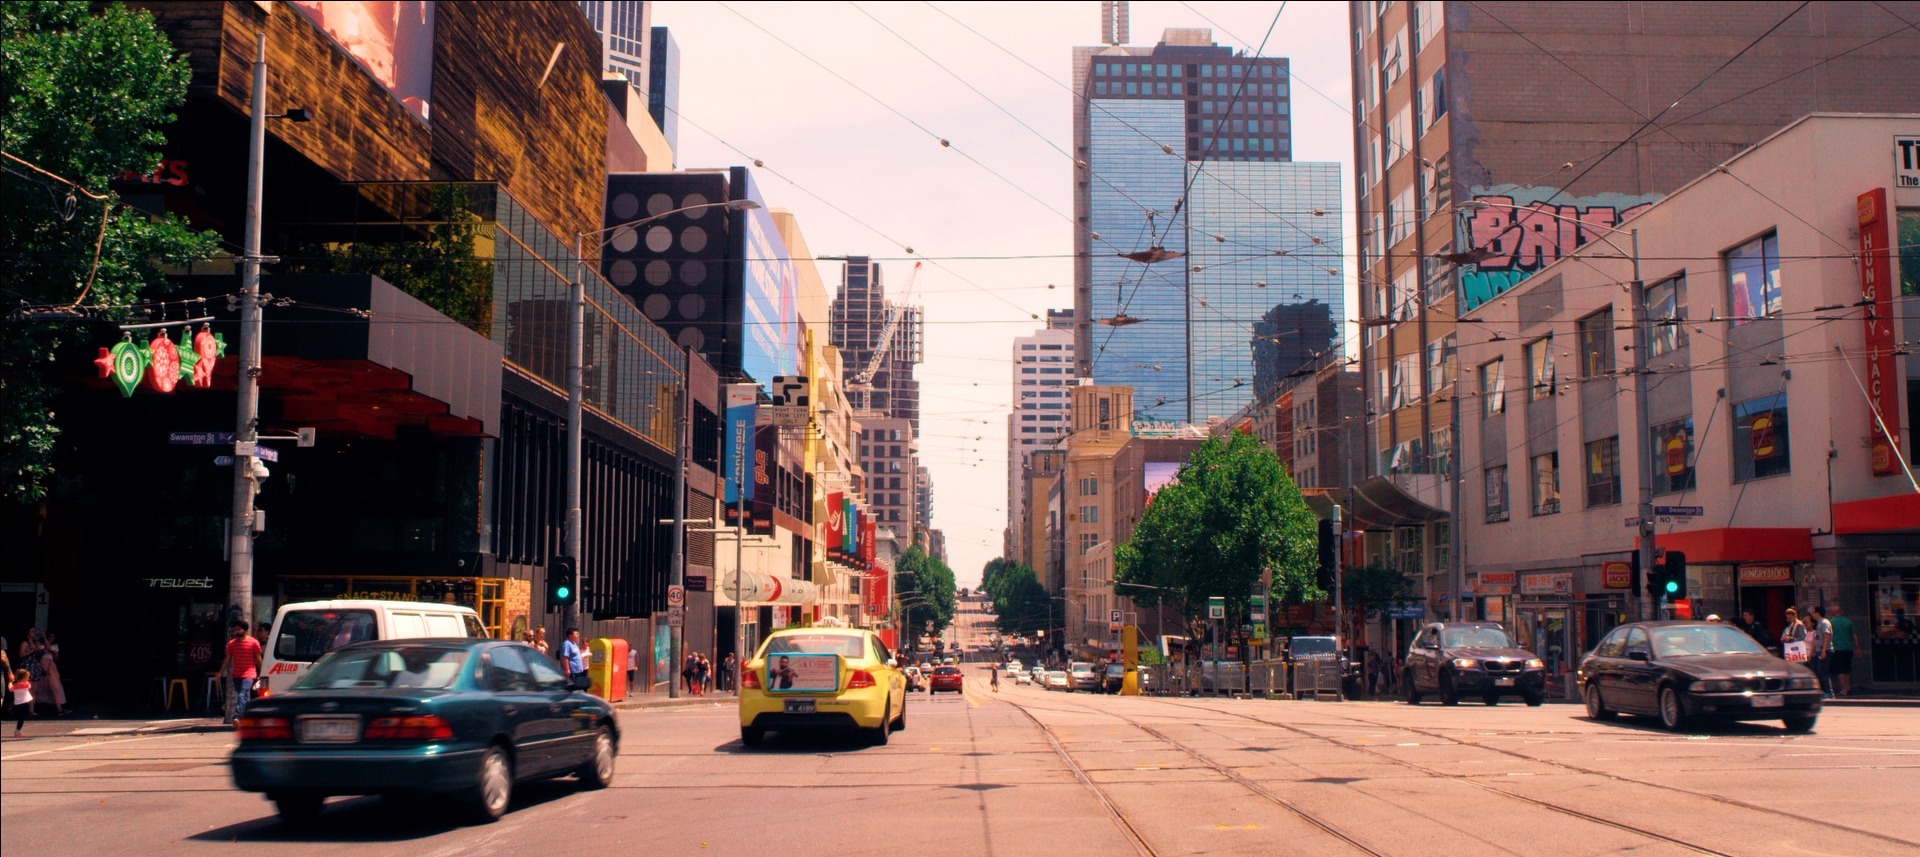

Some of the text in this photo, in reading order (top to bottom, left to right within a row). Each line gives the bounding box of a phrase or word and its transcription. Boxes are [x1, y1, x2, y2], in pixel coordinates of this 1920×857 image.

[1900, 175, 1919, 185] The
[1864, 233, 1877, 337] HUNGRY
[207, 433, 215, 441] St
[755, 449, 770, 485] glue
[38, 593, 47, 605] 1
[669, 591, 682, 600] 40
[1112, 611, 1121, 621] P
[270, 662, 298, 675] ALLIED
